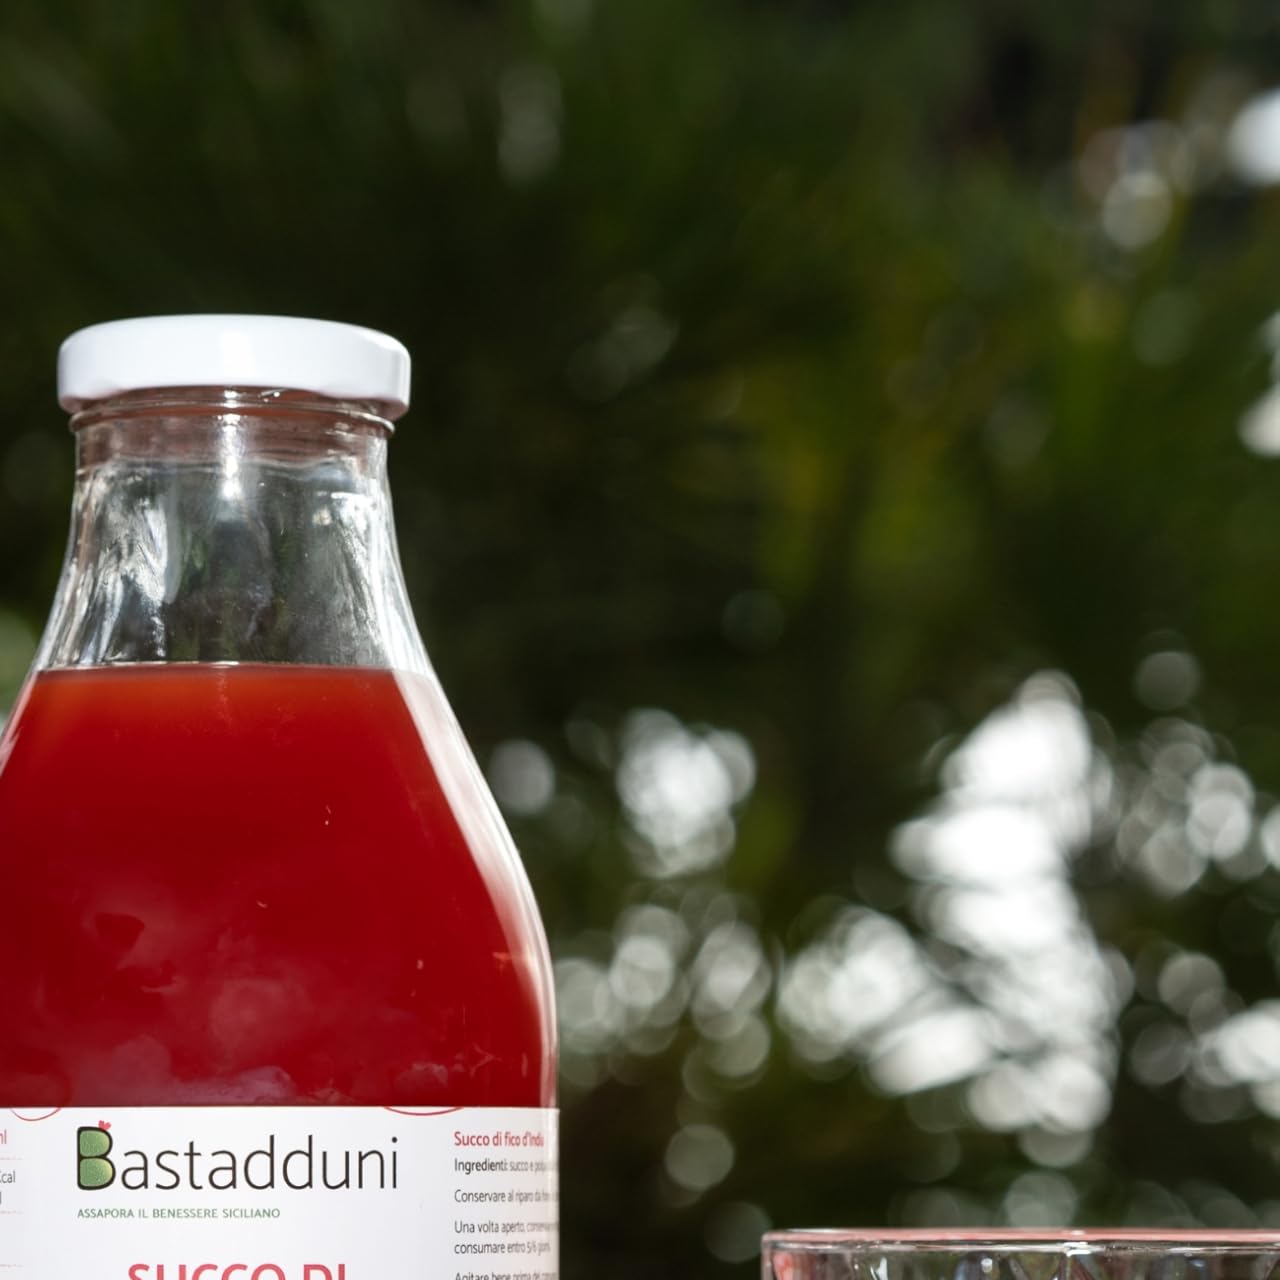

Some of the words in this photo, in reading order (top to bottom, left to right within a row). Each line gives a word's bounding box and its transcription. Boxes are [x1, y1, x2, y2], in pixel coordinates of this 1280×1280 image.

[454, 1131, 490, 1146] Succo
[492, 1131, 502, 1146] di
[504, 1131, 521, 1146] fico
[76, 1126, 399, 1191] Bastadduni
[454, 1189, 506, 1203] Conservare
[508, 1189, 515, 1202] al
[77, 1208, 135, 1219] ASSAPORA
[138, 1208, 149, 1219] IL
[152, 1208, 219, 1219] BENESSERE
[222, 1208, 281, 1219] SICILIANO
[454, 1221, 475, 1233] Una
[477, 1220, 499, 1233] volta
[454, 1243, 505, 1254] consumare
